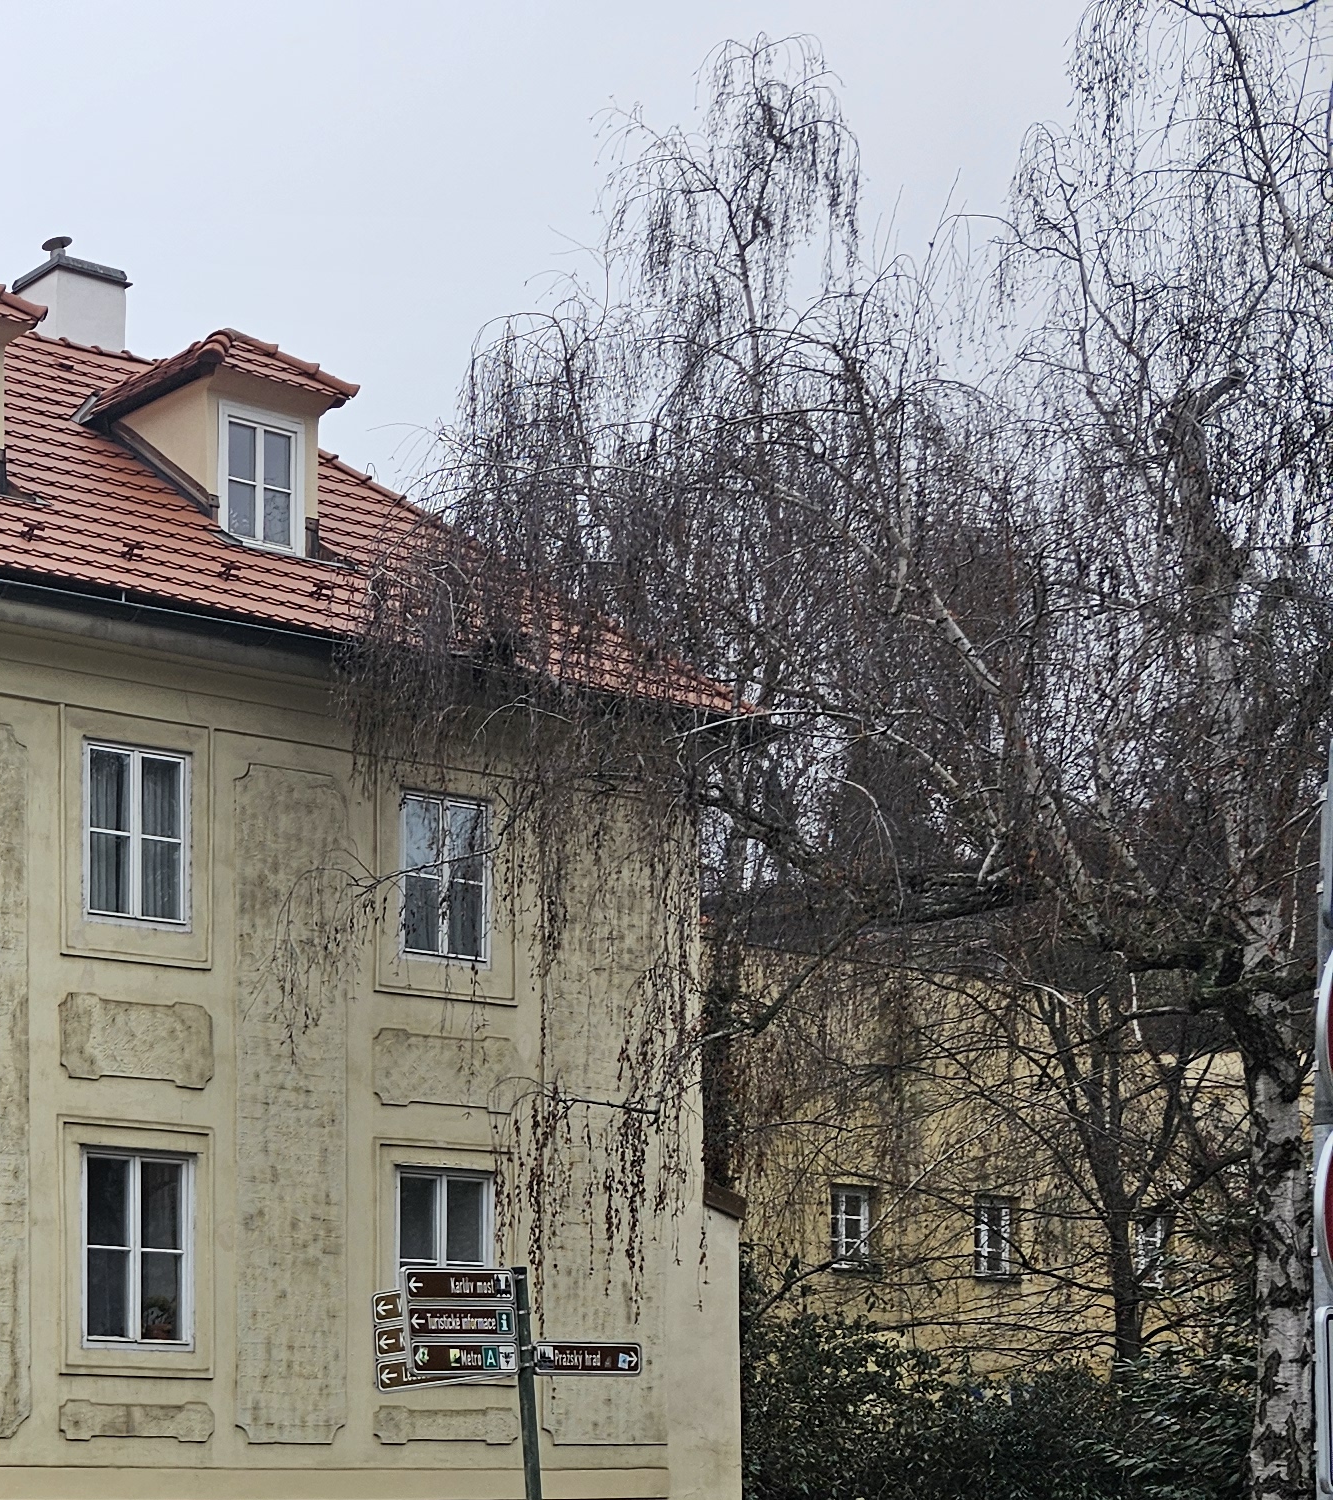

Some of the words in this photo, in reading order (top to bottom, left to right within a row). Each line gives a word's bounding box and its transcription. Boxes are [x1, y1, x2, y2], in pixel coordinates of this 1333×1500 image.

[450, 1277, 474, 1294] Karlův
[477, 1278, 495, 1294] most
[427, 1313, 461, 1330] Turistické
[462, 1315, 496, 1330] informace
[461, 1350, 482, 1366] Metro
[486, 1350, 497, 1367] A
[554, 1350, 583, 1369] Pražský
[585, 1350, 601, 1367] hrad
